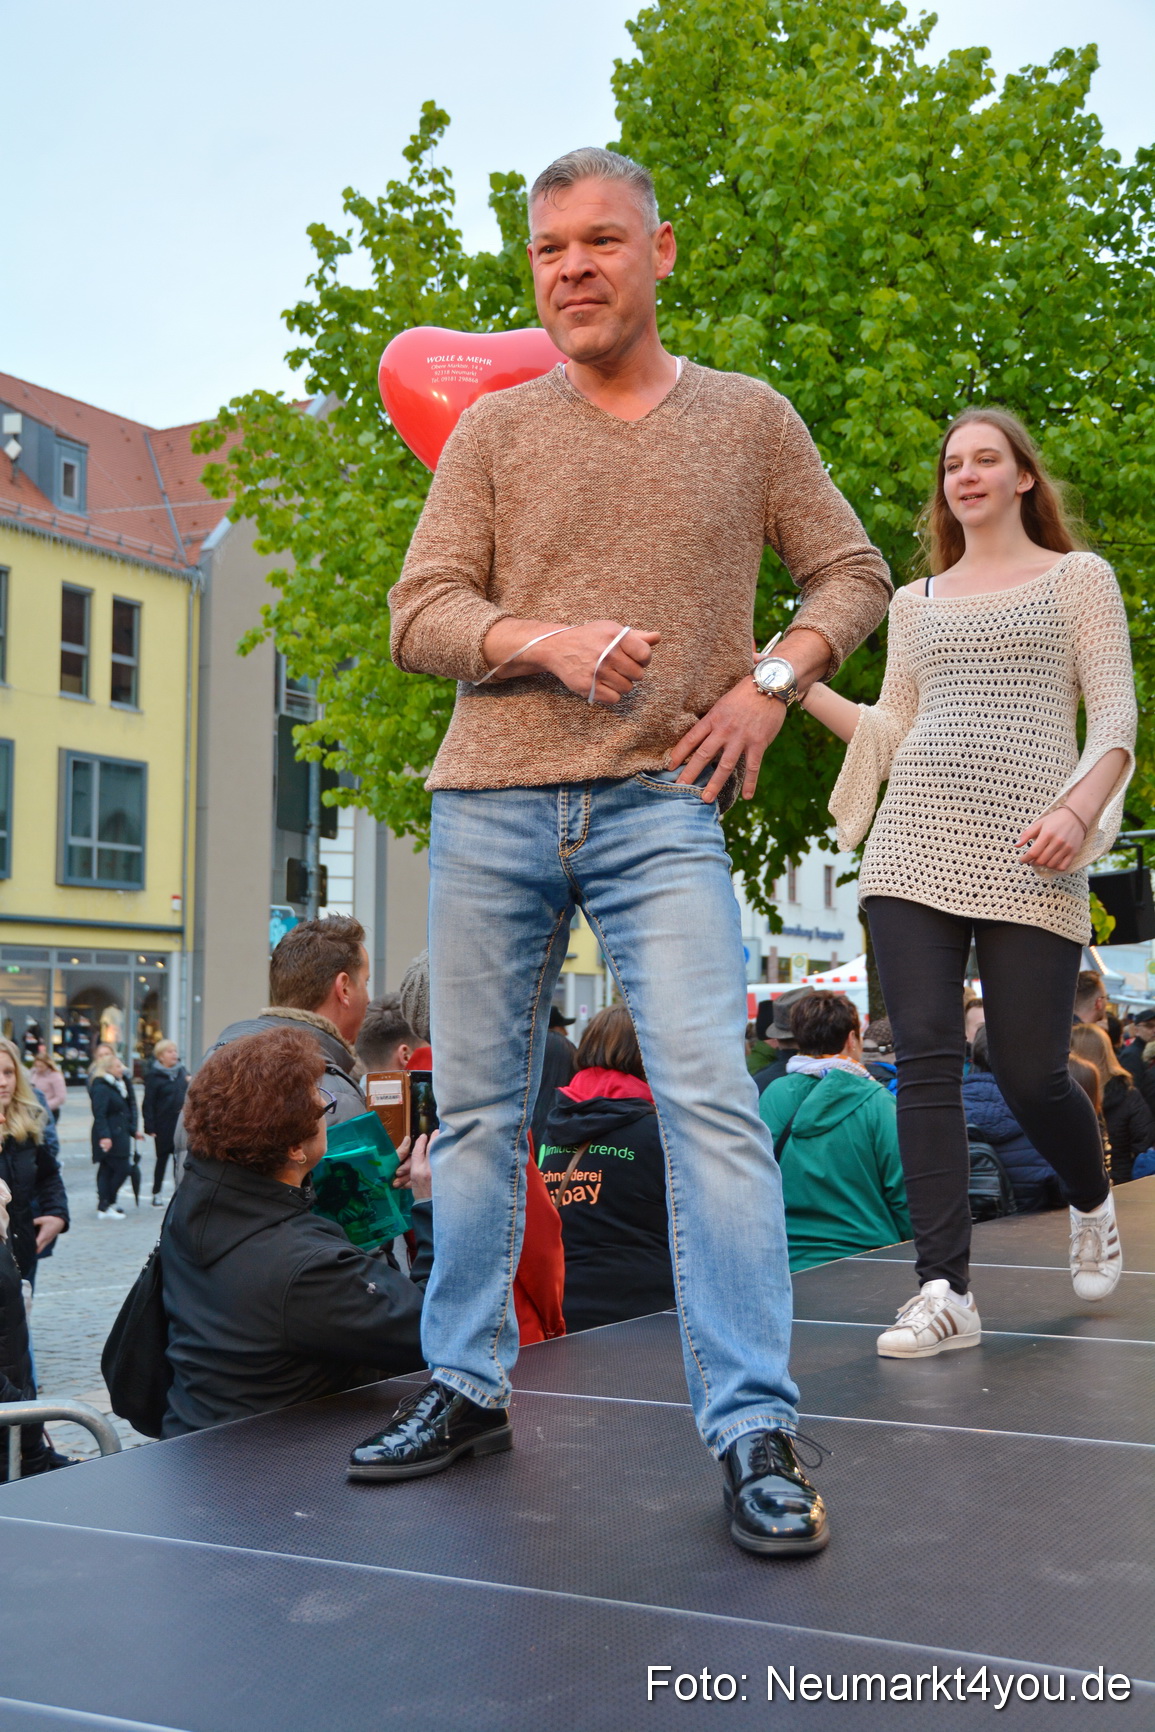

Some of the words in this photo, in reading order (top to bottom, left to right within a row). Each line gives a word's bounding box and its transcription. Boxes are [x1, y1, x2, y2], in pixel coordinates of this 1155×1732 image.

[426, 355, 456, 364] WOLLE
[466, 355, 493, 366] MEHR
[588, 1144, 635, 1161] trends
[540, 1168, 603, 1183] chnederei
